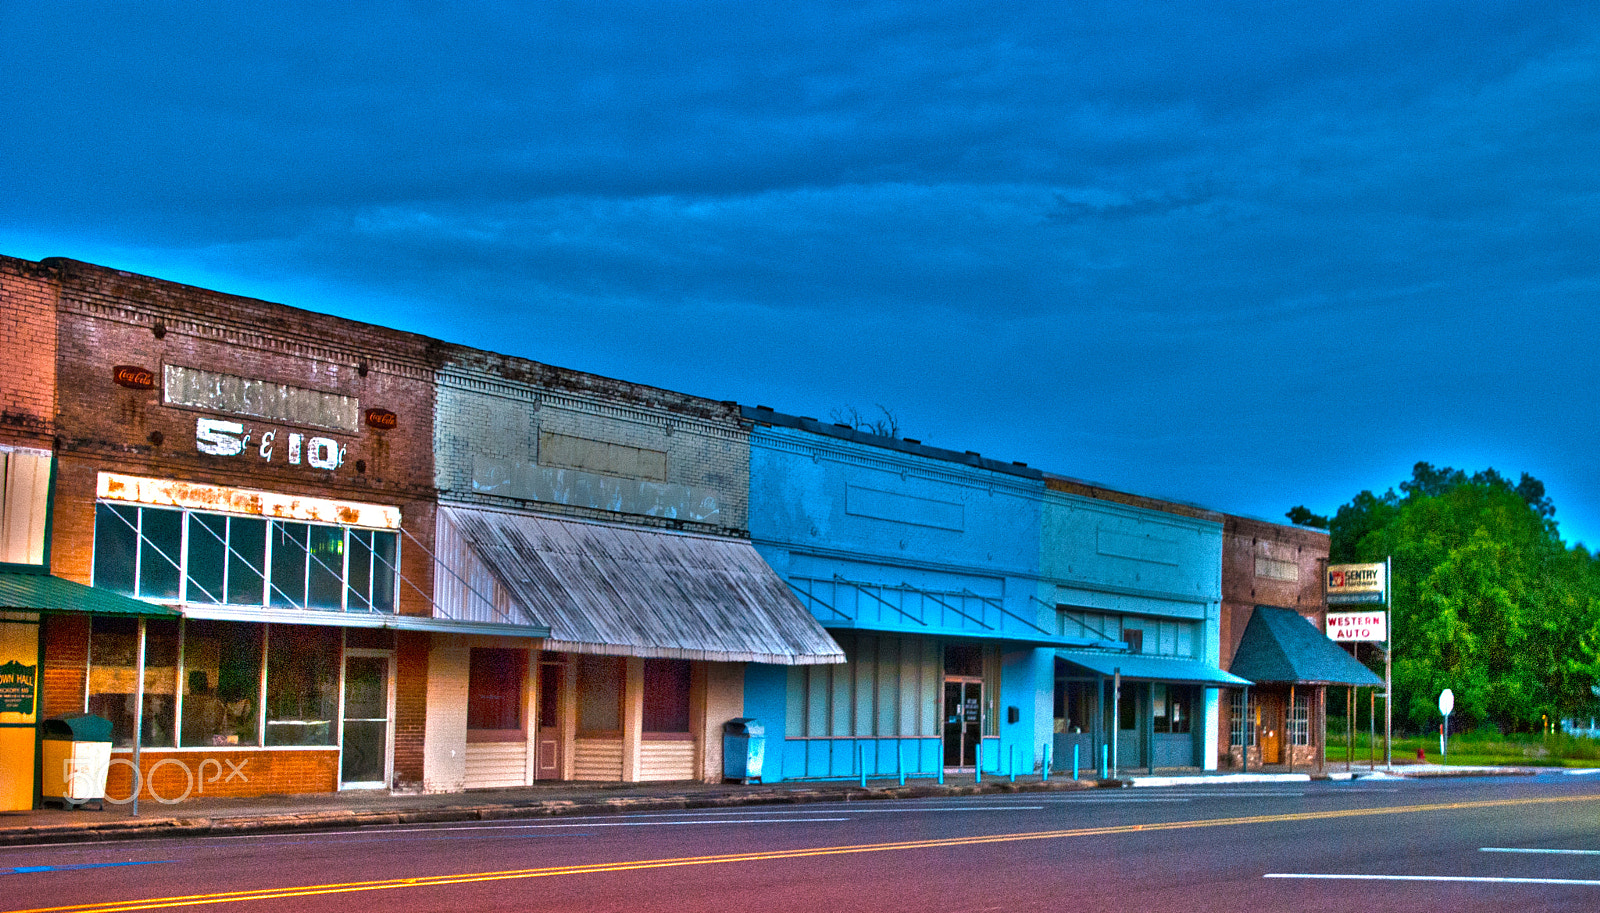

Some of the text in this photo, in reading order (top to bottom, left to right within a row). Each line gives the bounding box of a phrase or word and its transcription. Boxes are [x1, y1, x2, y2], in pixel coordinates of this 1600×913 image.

[1345, 569, 1378, 581] SENTRY
[1328, 616, 1380, 627] WESTERN
[1337, 628, 1370, 639] AUTO
[0, 674, 33, 687] OWN HALL
